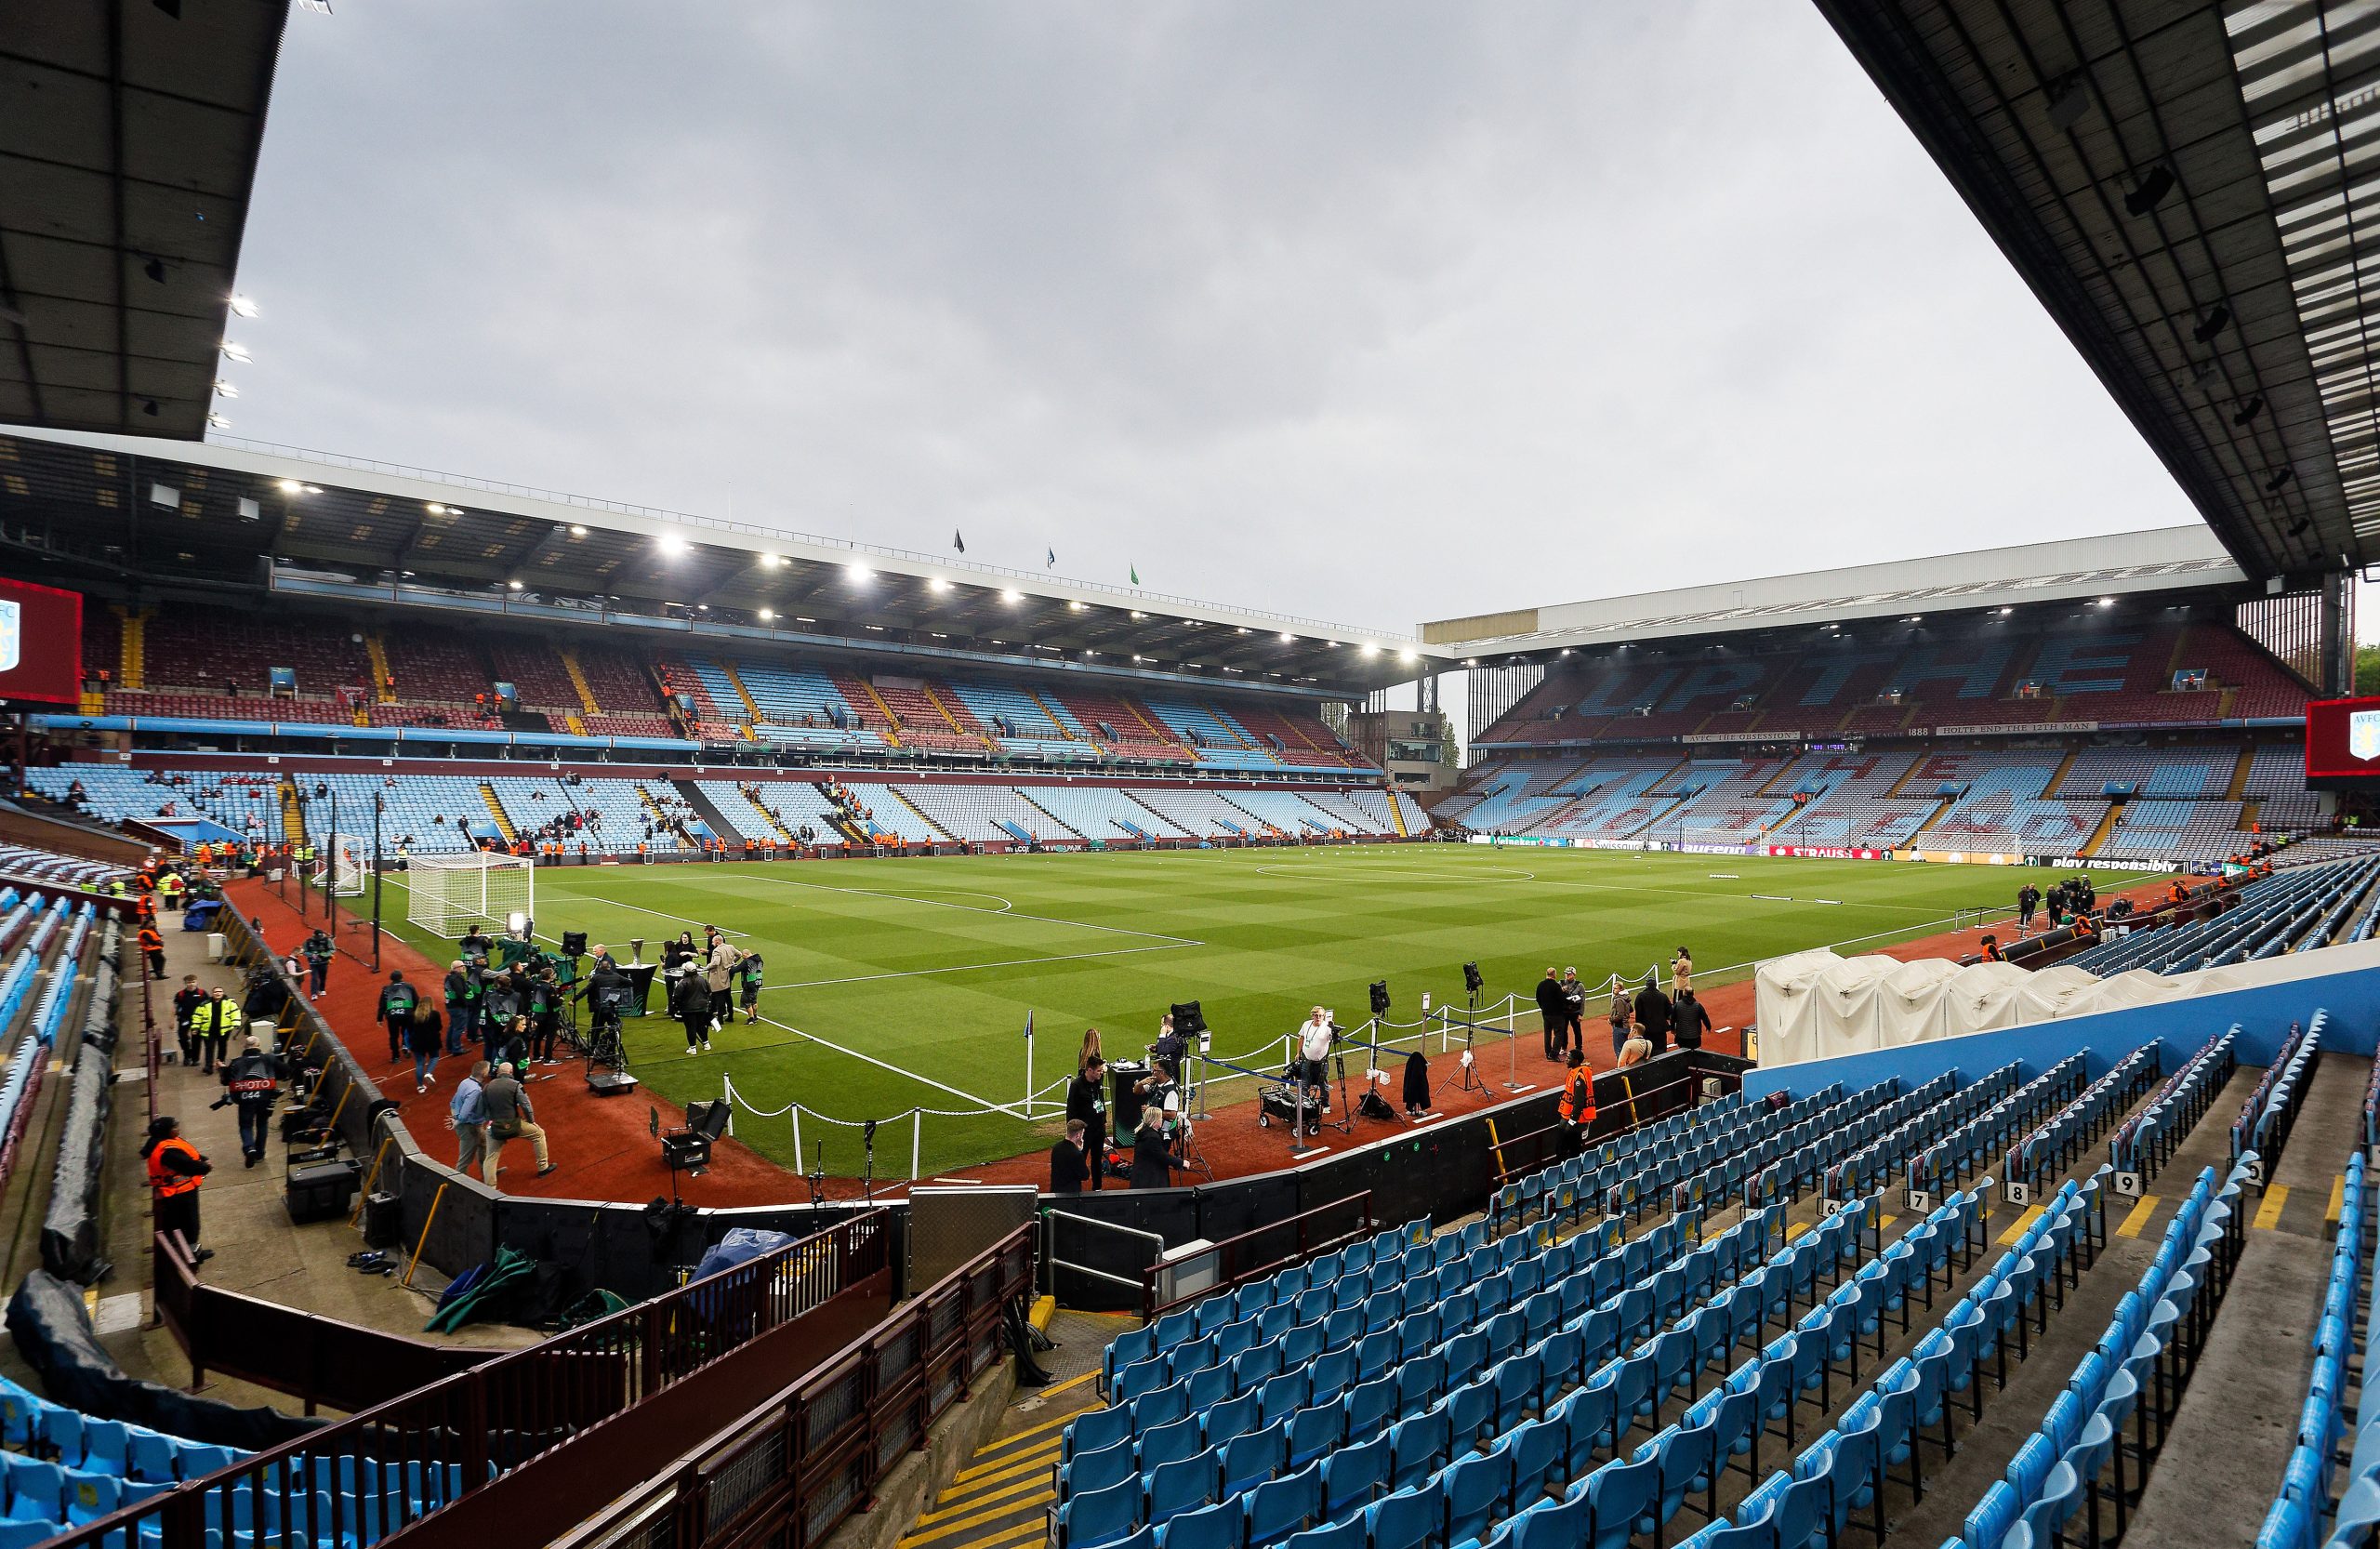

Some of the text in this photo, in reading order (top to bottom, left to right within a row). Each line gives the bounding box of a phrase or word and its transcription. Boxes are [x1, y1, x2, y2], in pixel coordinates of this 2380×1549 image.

[1909, 727, 1929, 736] 1888
[1942, 726, 1976, 735] HOLTE
[2007, 724, 2028, 733] THE
[2032, 723, 2058, 732] 12TH
[2063, 722, 2090, 731] MAN
[1718, 733, 1736, 741] THE
[1739, 732, 1792, 741] OBSESSION
[1793, 847, 1853, 859] STRAUSS
[2052, 857, 2178, 873] play responsibly
[234, 1079, 271, 1090] PHOTO
[241, 1091, 261, 1100] 044
[2122, 1176, 2134, 1191] 9
[2013, 1186, 2023, 1201] 8
[1914, 1194, 1924, 1208] 7
[1827, 1202, 1836, 1215] 6
